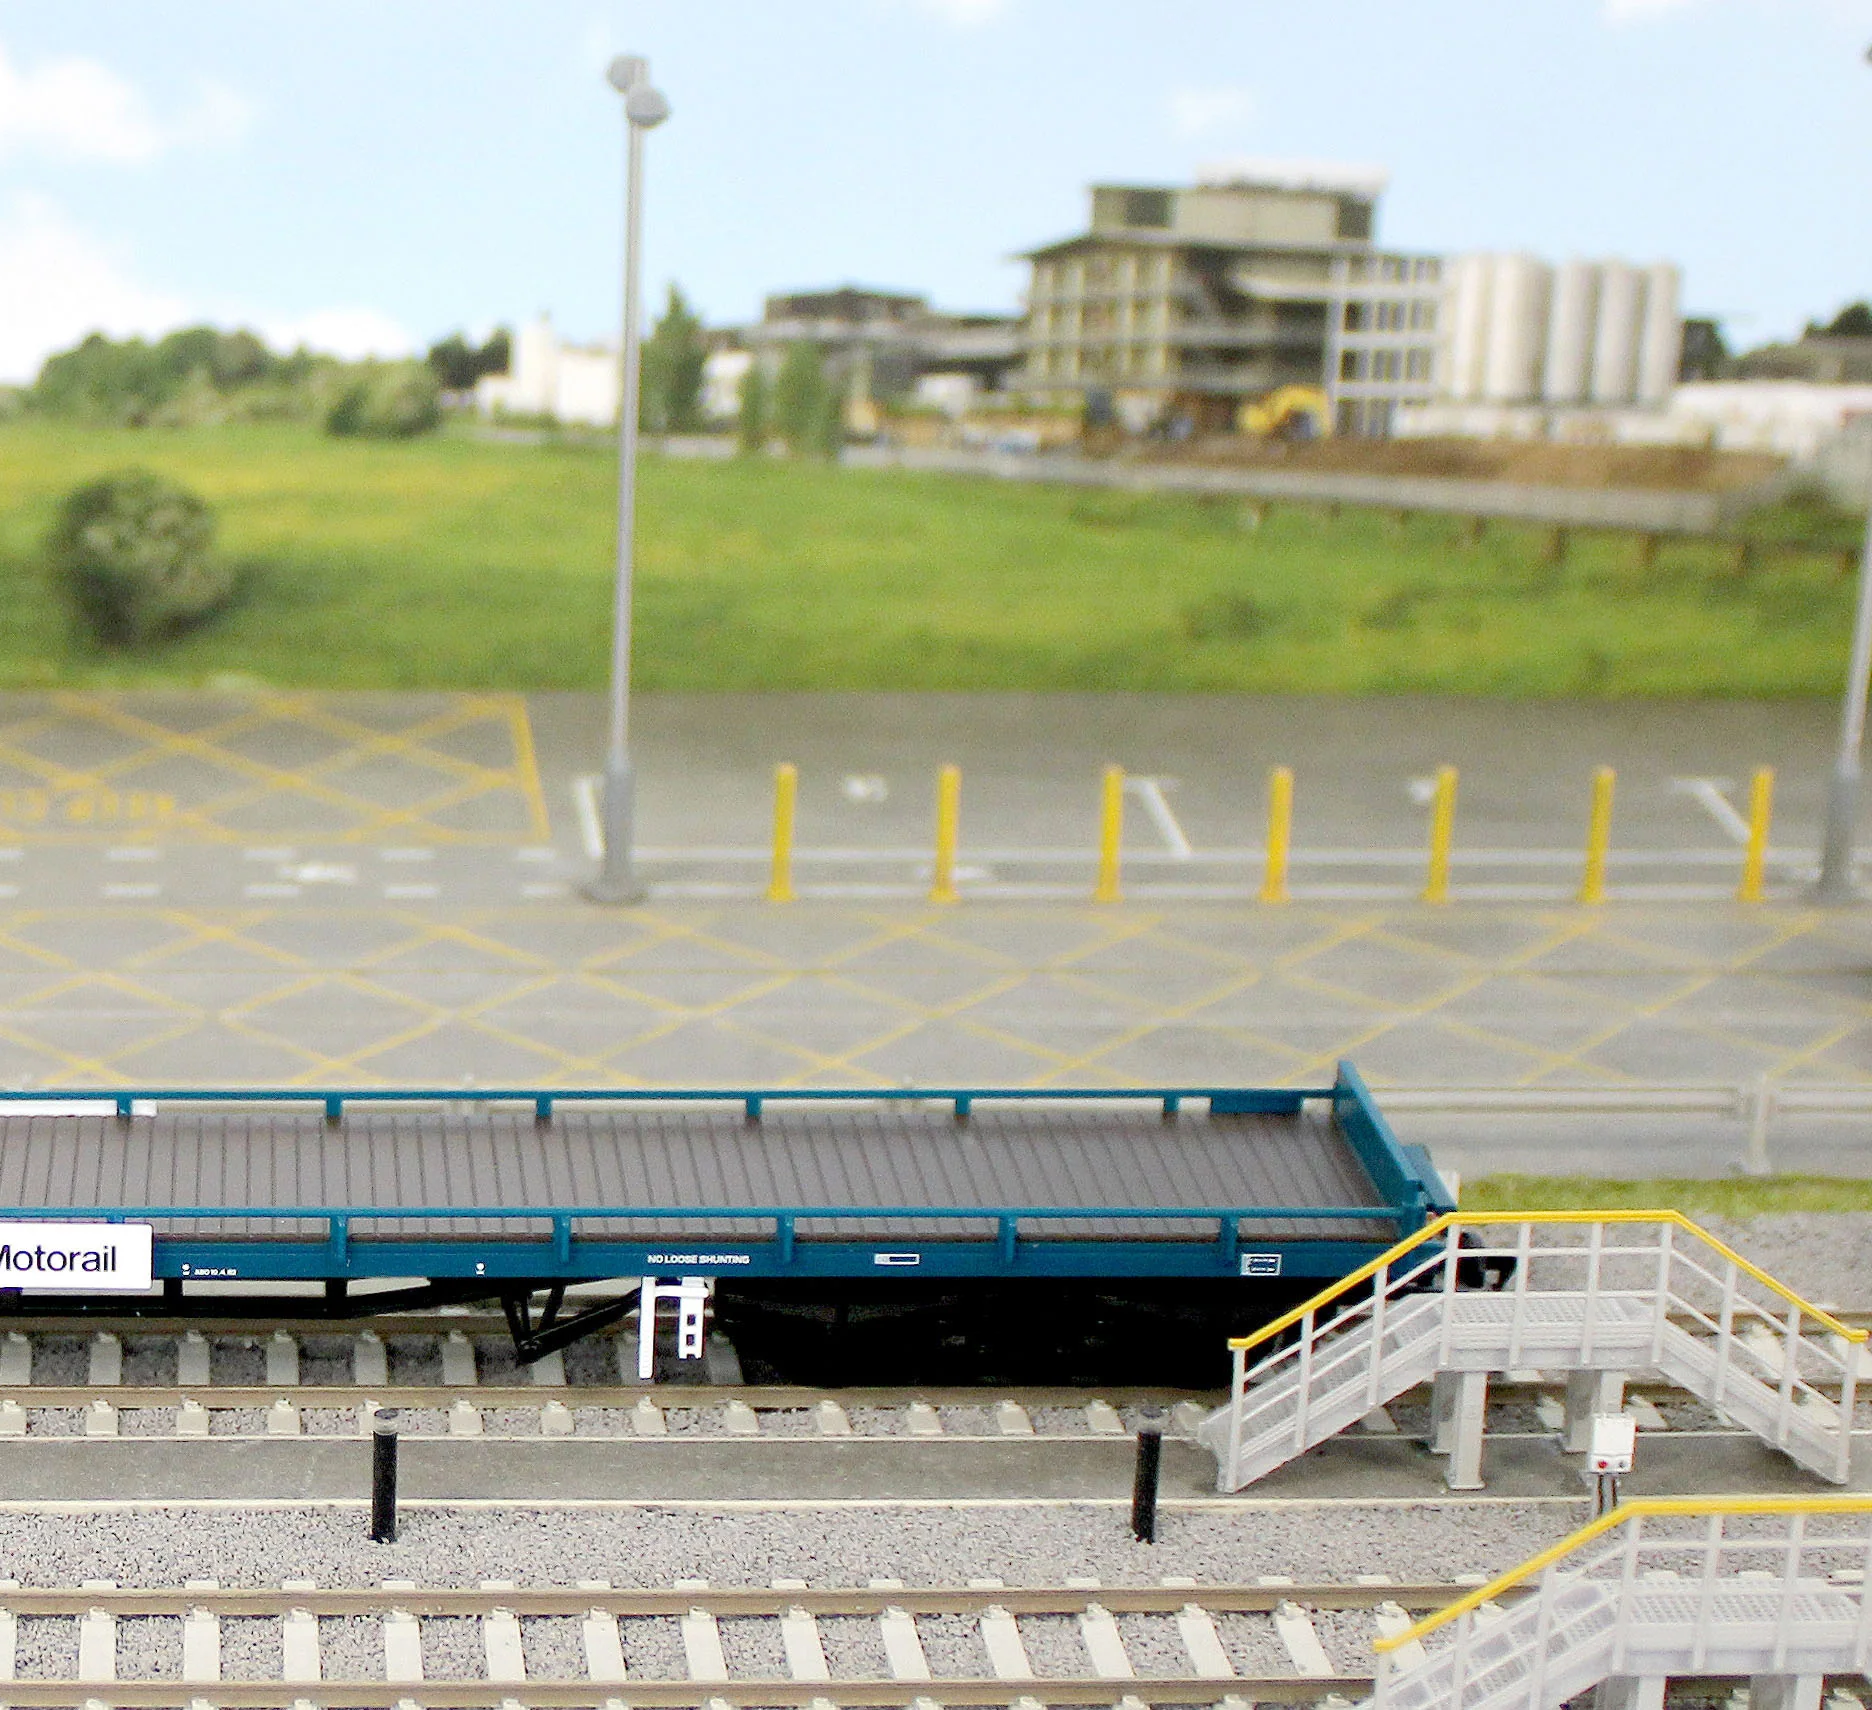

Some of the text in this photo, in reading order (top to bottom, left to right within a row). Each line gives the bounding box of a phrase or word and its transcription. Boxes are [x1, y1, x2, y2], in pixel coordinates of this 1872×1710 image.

[647, 1255, 750, 1264] NO LOOSE SHUNTING
